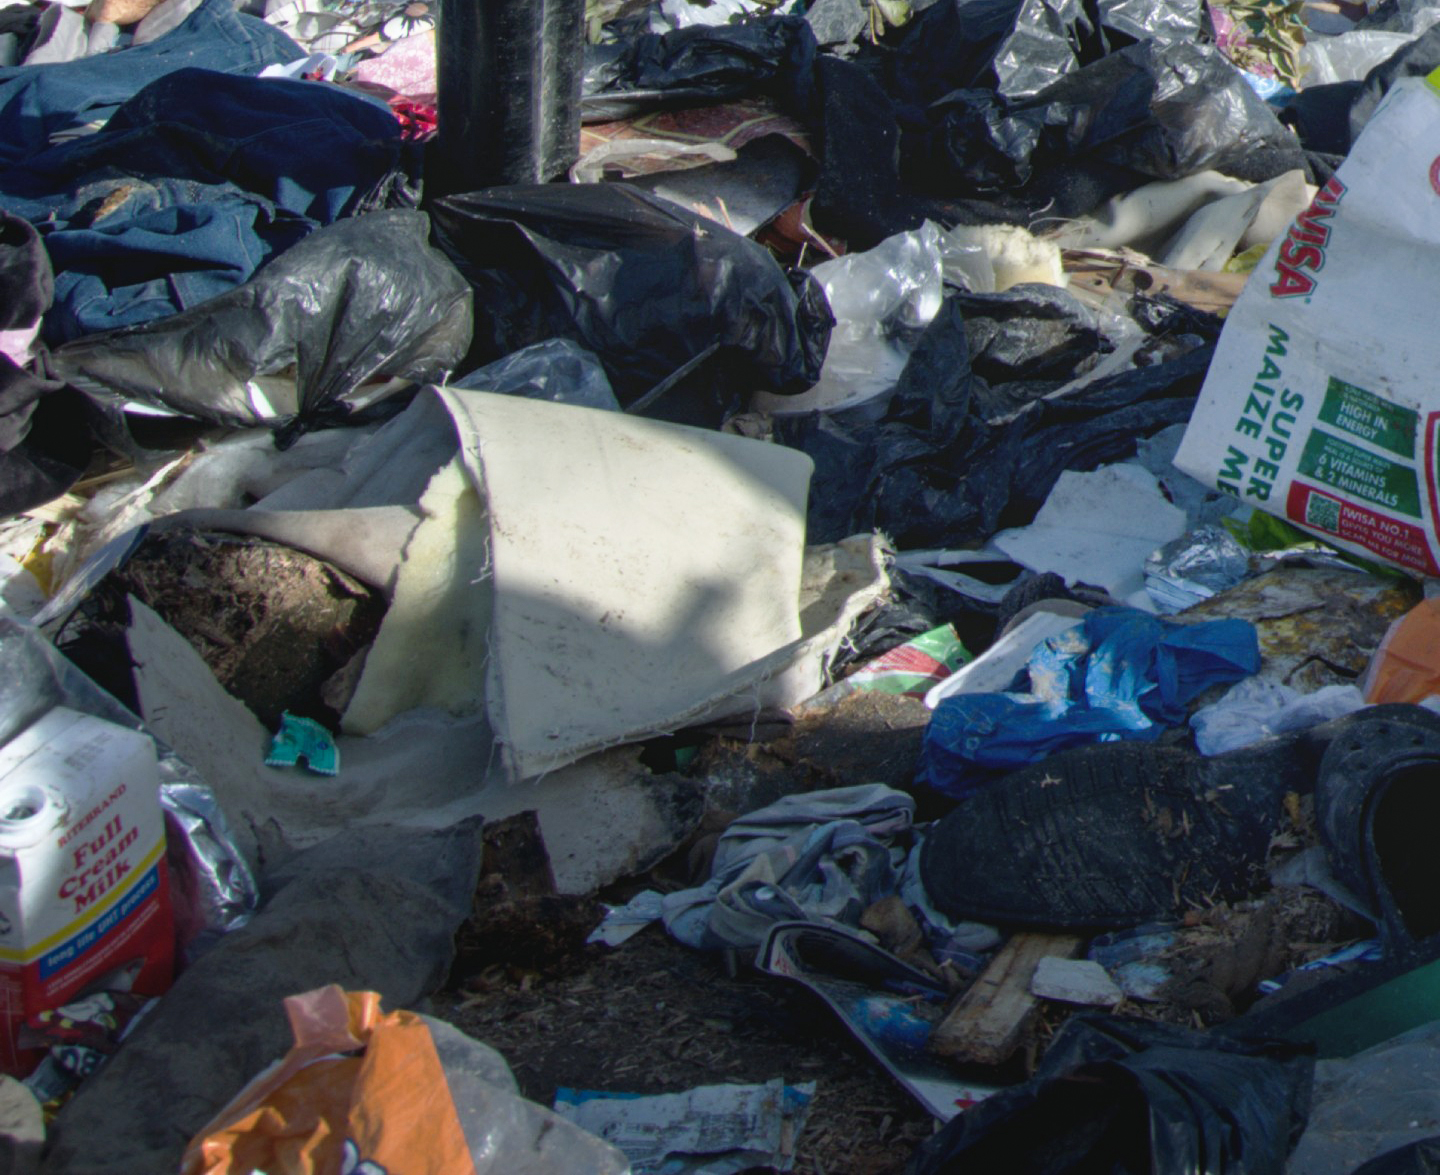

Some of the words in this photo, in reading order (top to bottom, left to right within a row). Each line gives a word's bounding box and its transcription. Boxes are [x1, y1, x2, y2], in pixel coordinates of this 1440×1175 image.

[1235, 323, 1290, 440] MAIZE
[1335, 413, 1378, 439] ENERGY
[1340, 401, 1372, 423] HIGH
[1373, 414, 1389, 431] IN
[1246, 388, 1304, 502] SUPER
[1318, 453, 1328, 465] 6
[1330, 456, 1387, 488] VITAMINS
[1314, 466, 1324, 478] &
[1327, 470, 1336, 484] 2
[1338, 476, 1399, 506] MINERALS
[1342, 507, 1377, 527] IWISA
[1372, 531, 1392, 544] YOU
[57, 783, 127, 849] RITEBRAND
[73, 814, 123, 870] Full
[58, 827, 139, 899] Cream
[74, 857, 131, 915] Milk
[47, 945, 75, 968] long
[77, 930, 97, 950] life
[98, 910, 120, 934] UHT
[121, 876, 157, 913] process
